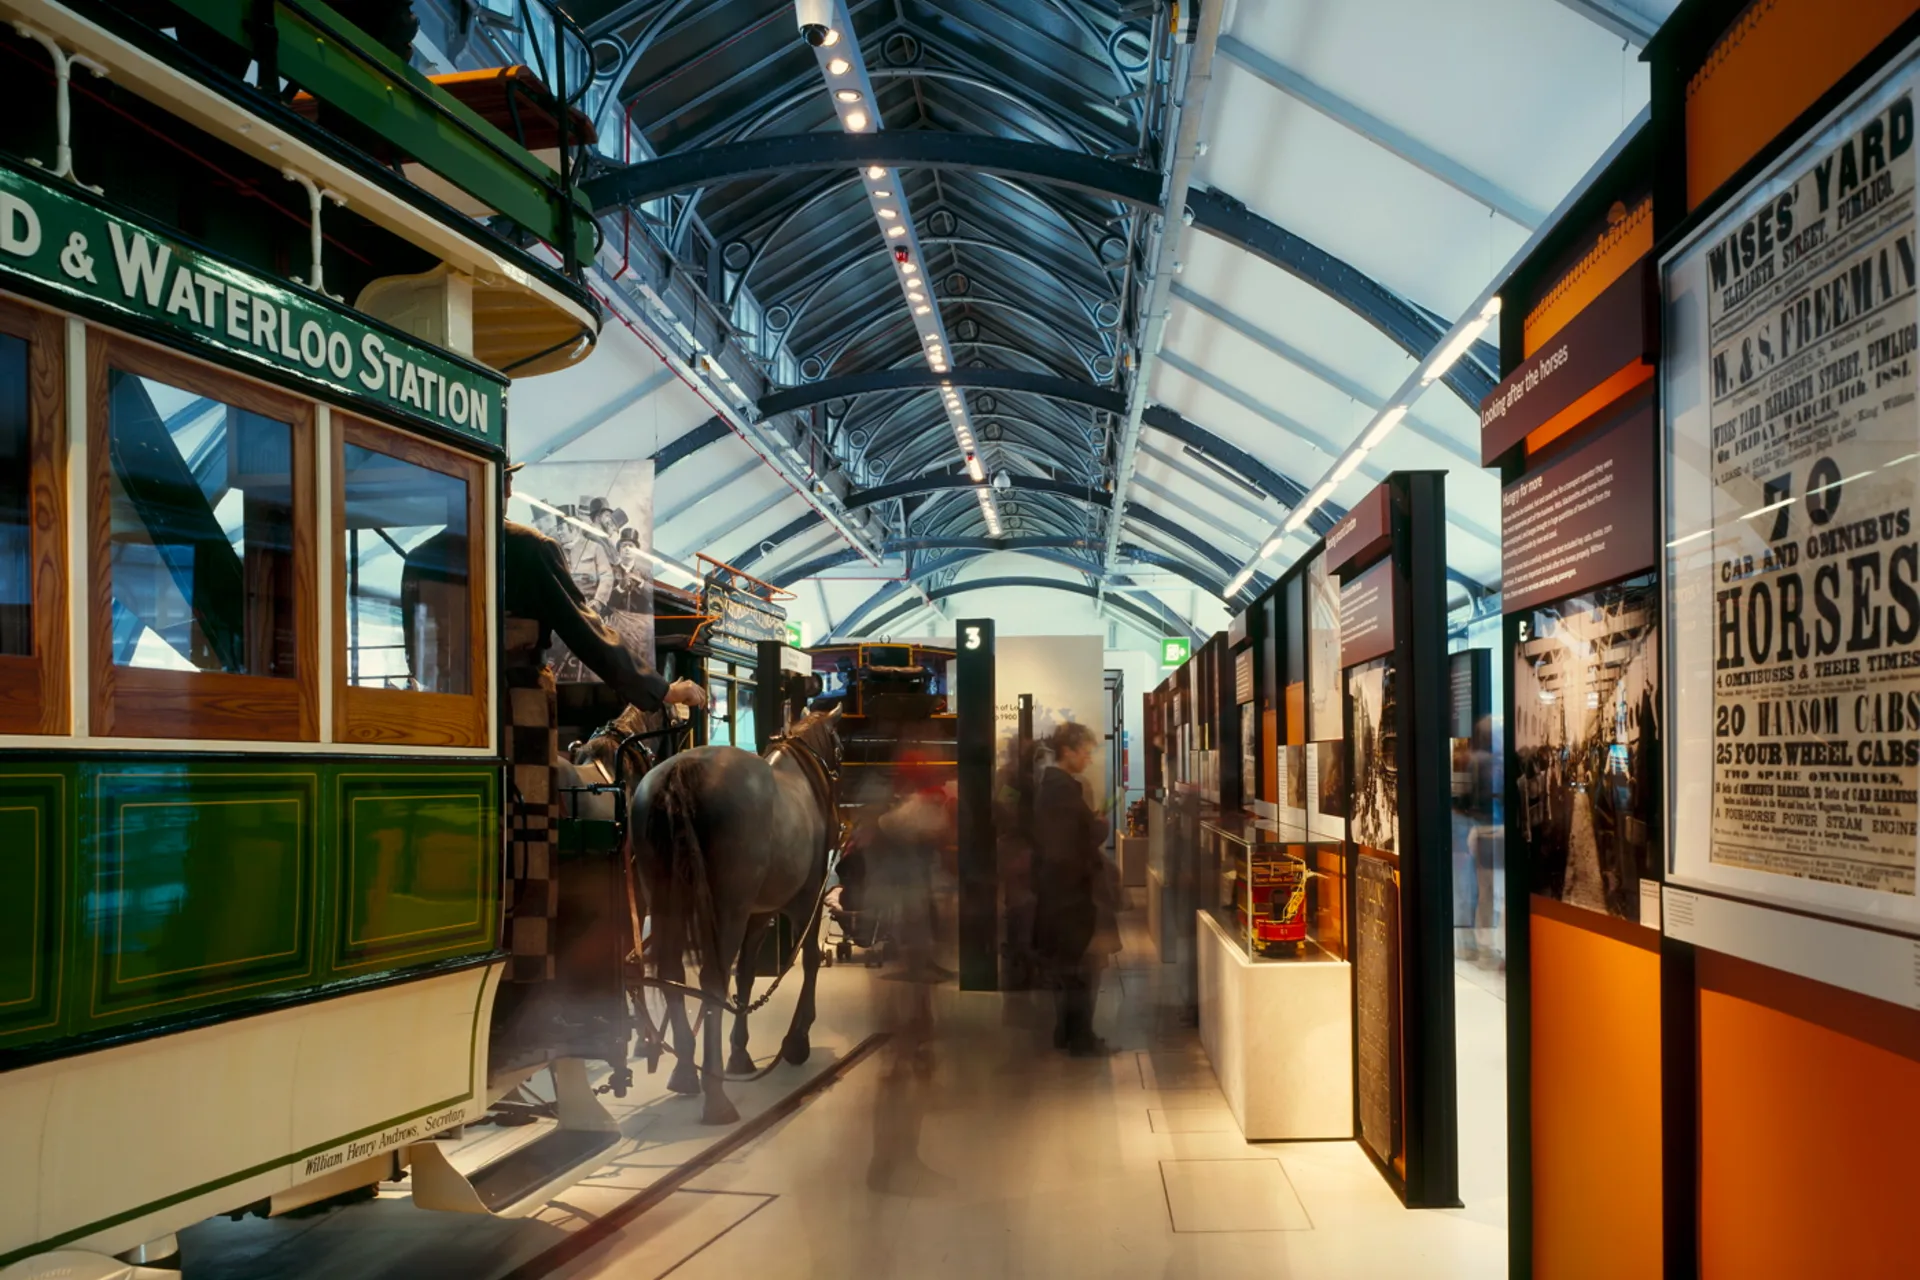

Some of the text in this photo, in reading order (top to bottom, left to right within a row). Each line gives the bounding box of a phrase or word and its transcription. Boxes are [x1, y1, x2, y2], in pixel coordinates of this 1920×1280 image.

[1710, 98, 1912, 289] WISES' YARD
[1723, 255, 1774, 311] ELIZABETH
[1782, 217, 1827, 268] STREET,
[60, 231, 97, 284] &
[107, 221, 352, 379] WATERLOO
[359, 332, 489, 434] STATION
[1713, 349, 1733, 397] W.
[1739, 337, 1753, 383] &
[1757, 324, 1774, 370] S.
[1781, 236, 1914, 356] FREEMAN
[1481, 345, 1568, 428] Looking after the horses
[1784, 395, 1830, 429] MARCH
[1503, 489, 1520, 508] Hungry
[1763, 456, 1842, 542] 70
[1763, 541, 1799, 572] AND
[1806, 508, 1910, 560] OMNIBUS
[965, 627, 982, 650] 3
[1717, 545, 1920, 667] HORSES
[1725, 665, 1794, 686] OMNIBUSES
[1798, 663, 1808, 679] &
[1814, 657, 1860, 677] THEIR
[1866, 646, 1920, 672] TIMES
[1716, 704, 1745, 737] 20
[1758, 696, 1838, 736] HANSOM
[1854, 690, 1920, 732] CABS
[1716, 743, 1732, 764] 25
[1784, 740, 1852, 765] WHEEL
[1857, 739, 1920, 766] CABS
[1782, 812, 1817, 826] POWER
[1826, 815, 1862, 830] STEAM
[1872, 819, 1916, 835] ENGINE
[305, 1107, 466, 1176] William Henry Andrews, Secretary
